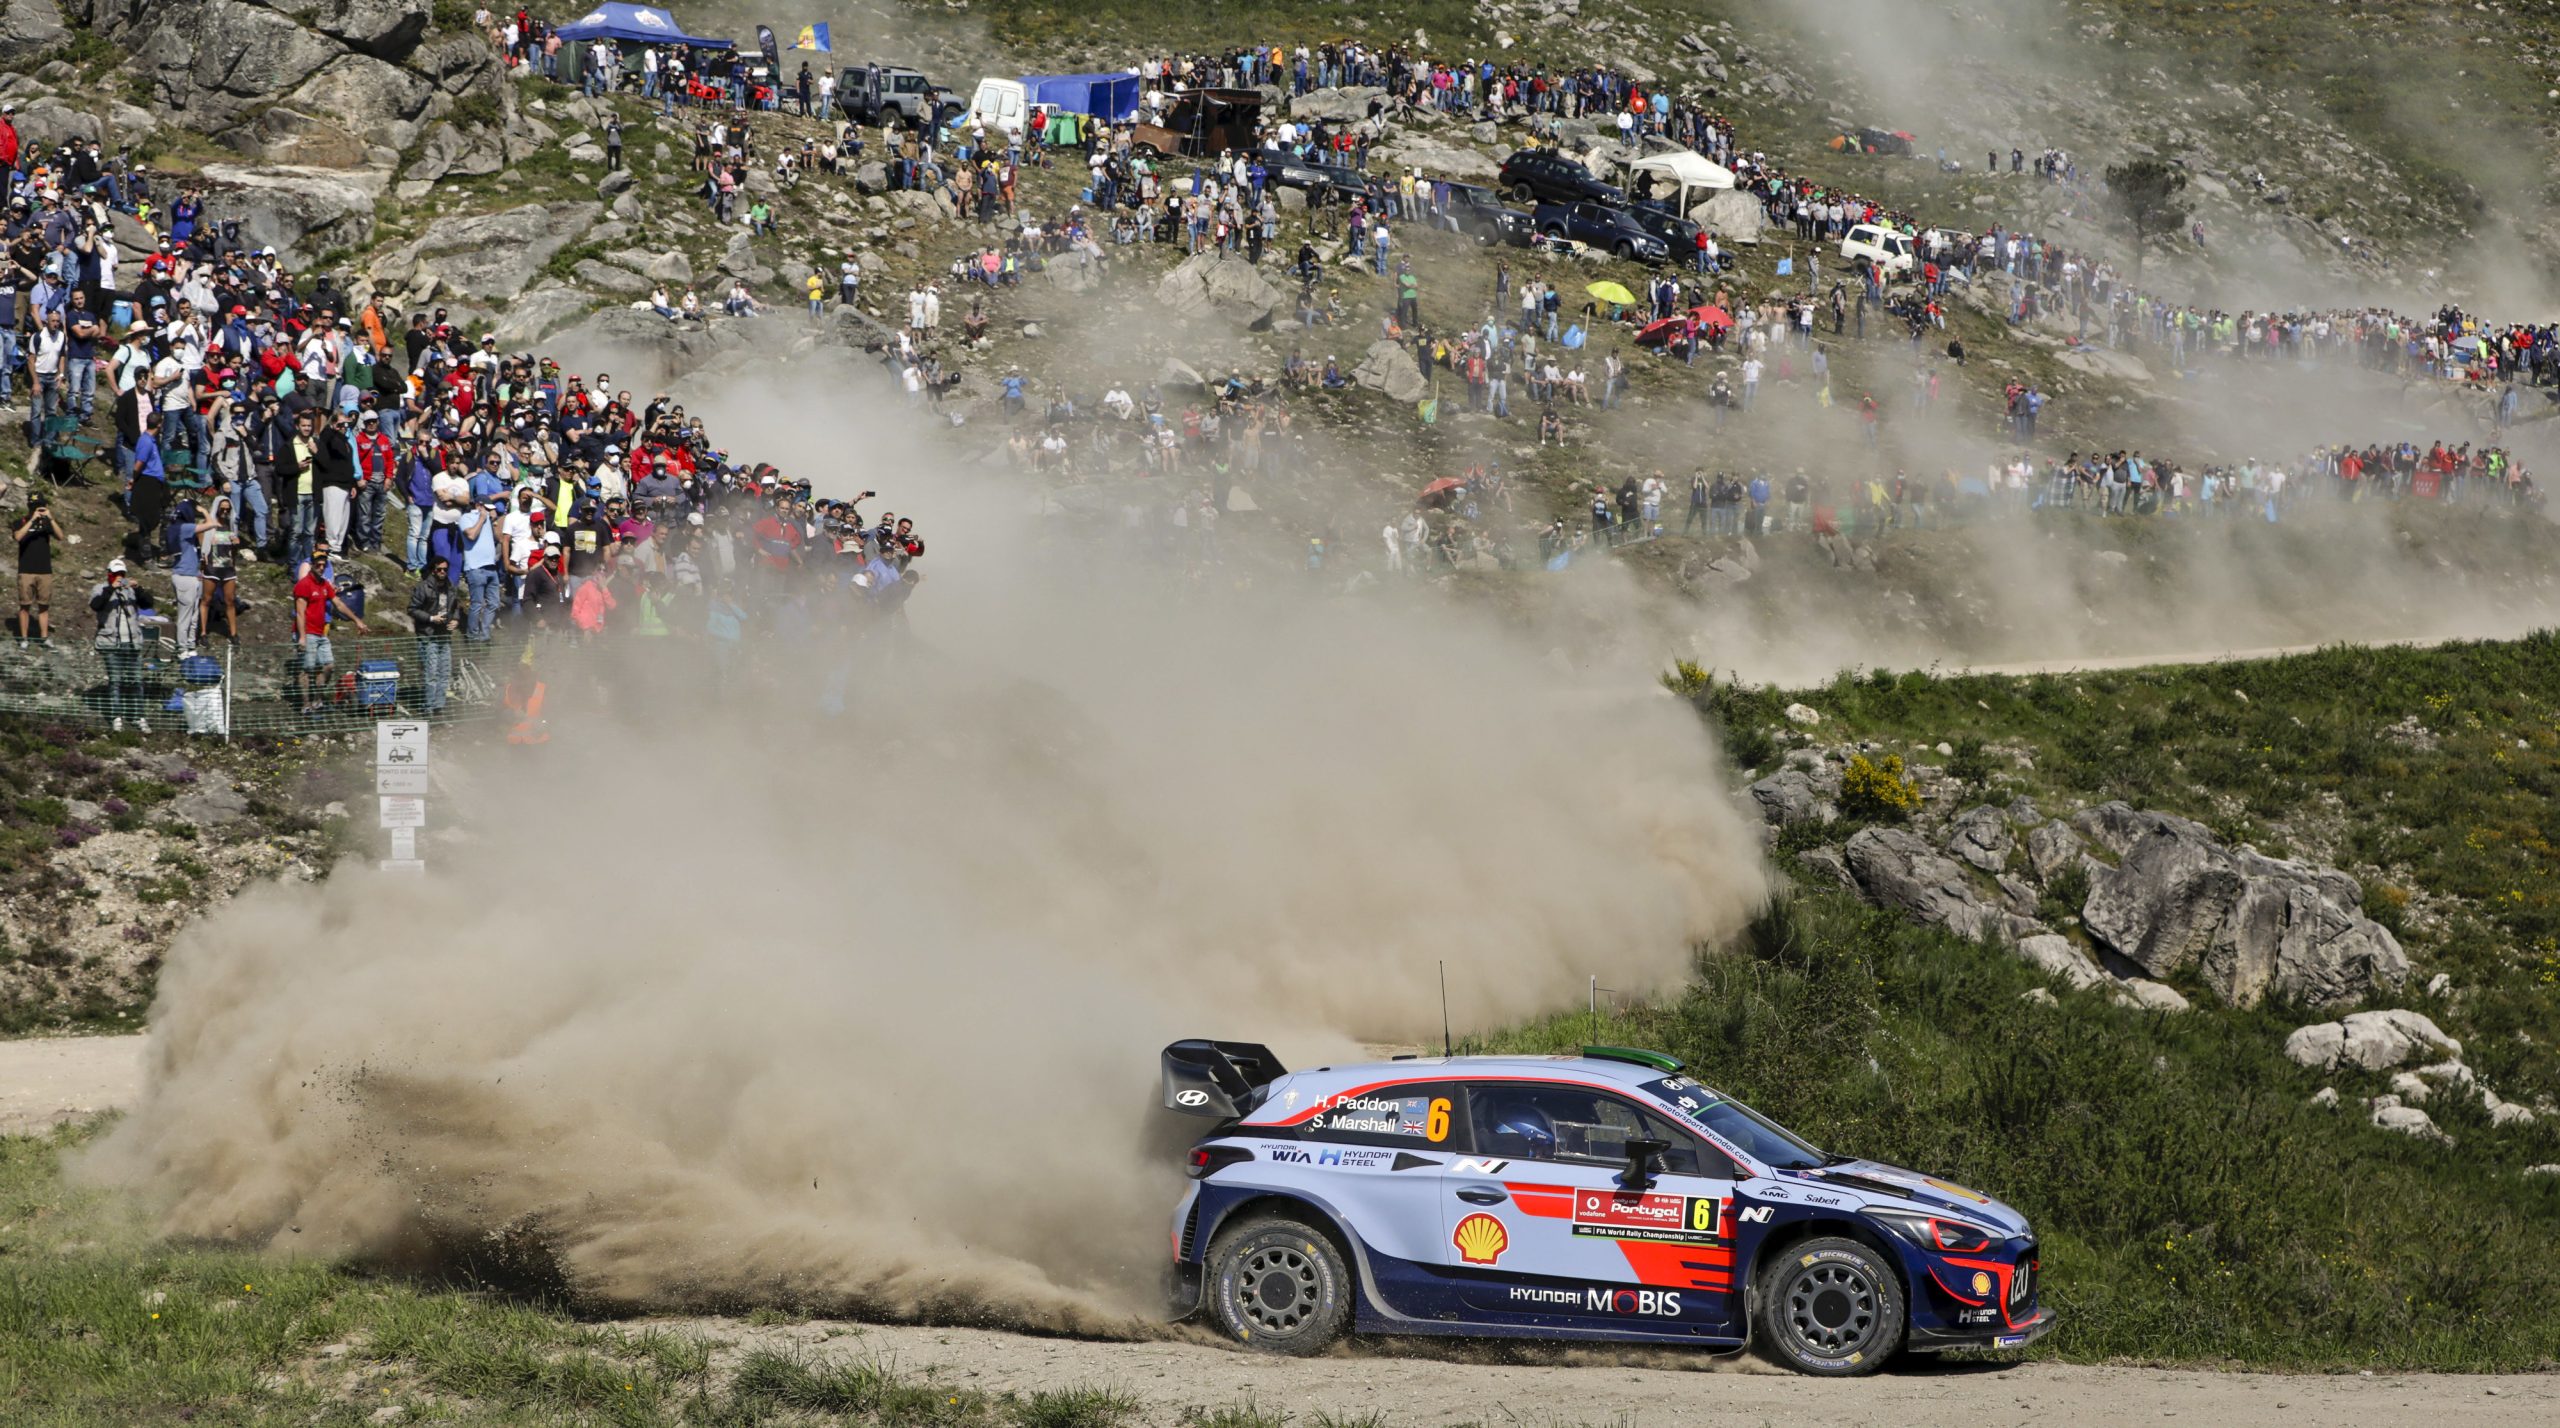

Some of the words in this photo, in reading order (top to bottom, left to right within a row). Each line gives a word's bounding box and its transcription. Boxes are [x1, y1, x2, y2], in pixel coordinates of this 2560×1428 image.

[1314, 1094, 1331, 1109] H.
[1336, 1095, 1400, 1112] Paddon
[1312, 1114, 1327, 1129] S.
[1331, 1115, 1396, 1133] Marshall
[1426, 1097, 1452, 1142] 6
[1658, 1102, 1752, 1166] motorsport.hyundai.com
[1341, 1159, 1376, 1167] STEEL
[1343, 1150, 1392, 1159] HYUNDAI
[1759, 1190, 1789, 1199] AMG
[1610, 1203, 1680, 1218] Portugal
[1693, 1199, 1710, 1230] 6
[1626, 1230, 1642, 1238] Rally
[1642, 1231, 1684, 1241] Championship
[1819, 1250, 1863, 1265] MICHELIN
[1317, 1259, 1333, 1305] MICHELIN
[1221, 1278, 1240, 1324] MICHELIN
[1510, 1287, 1581, 1305] HYUNDAI
[1587, 1287, 1681, 1316] MOBIS
